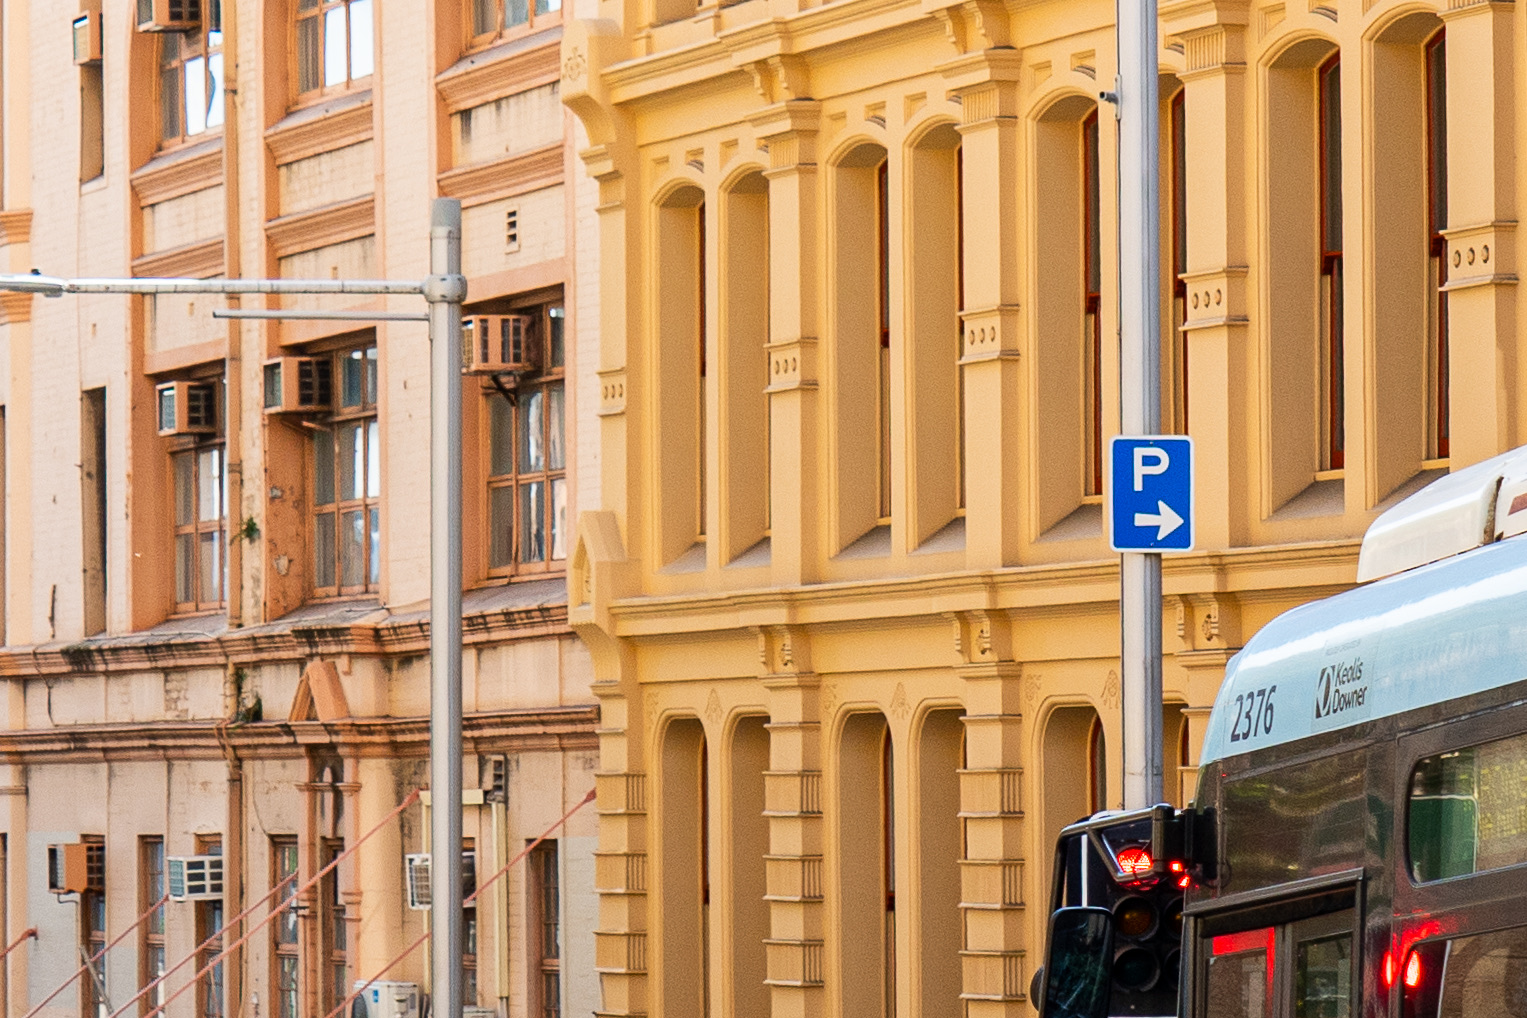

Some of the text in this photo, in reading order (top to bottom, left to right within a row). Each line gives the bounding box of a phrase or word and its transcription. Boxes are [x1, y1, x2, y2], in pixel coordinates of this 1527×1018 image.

[1133, 446, 1170, 492] P
[1334, 657, 1363, 687] Keolis
[1230, 684, 1277, 743] 2376
[1332, 686, 1367, 714] Downer
